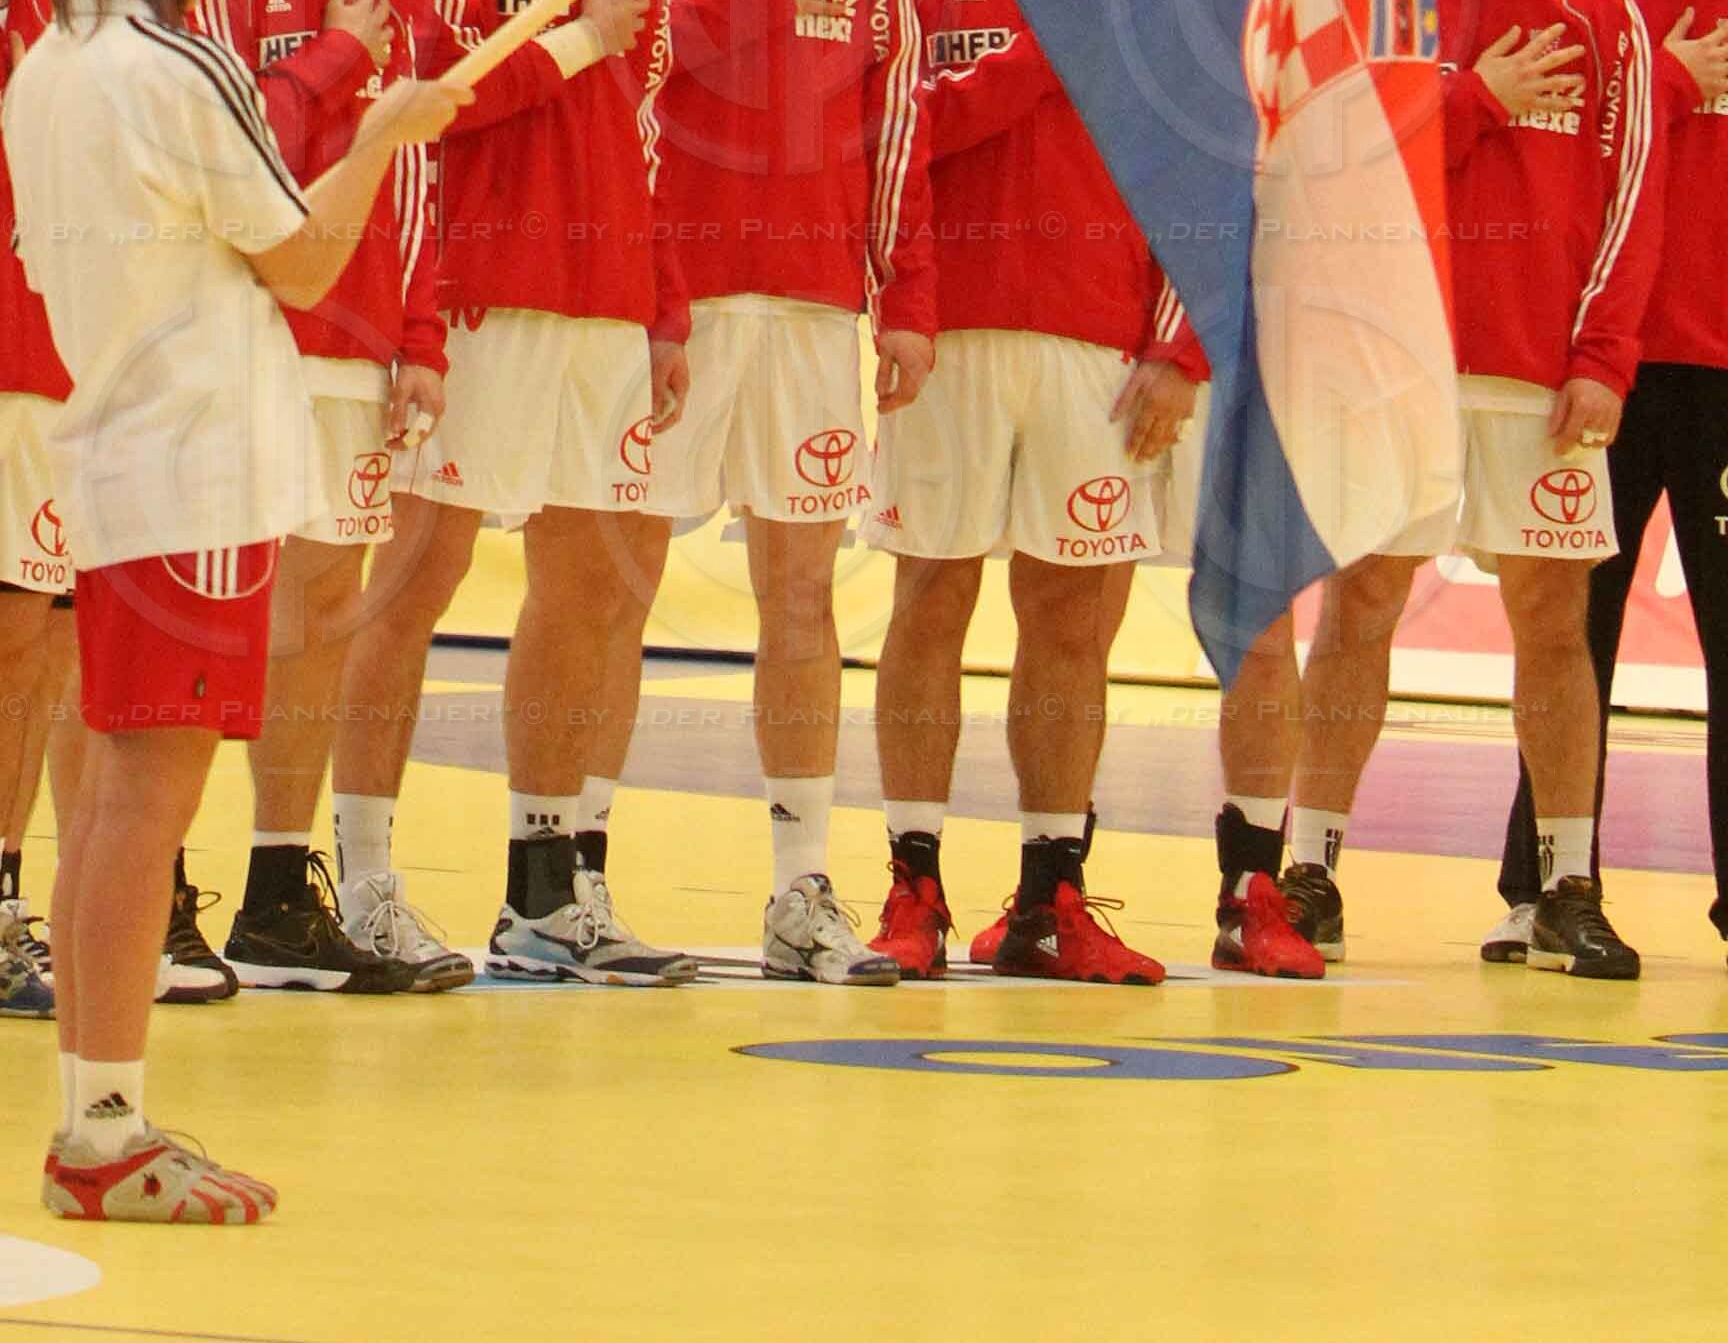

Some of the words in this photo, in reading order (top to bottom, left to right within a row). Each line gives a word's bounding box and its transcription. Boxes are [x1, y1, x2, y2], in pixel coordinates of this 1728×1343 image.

[786, 485, 872, 515] TOYOTA
[1055, 532, 1148, 557] TOYOTA
[1520, 528, 1609, 549] TOYOTA
